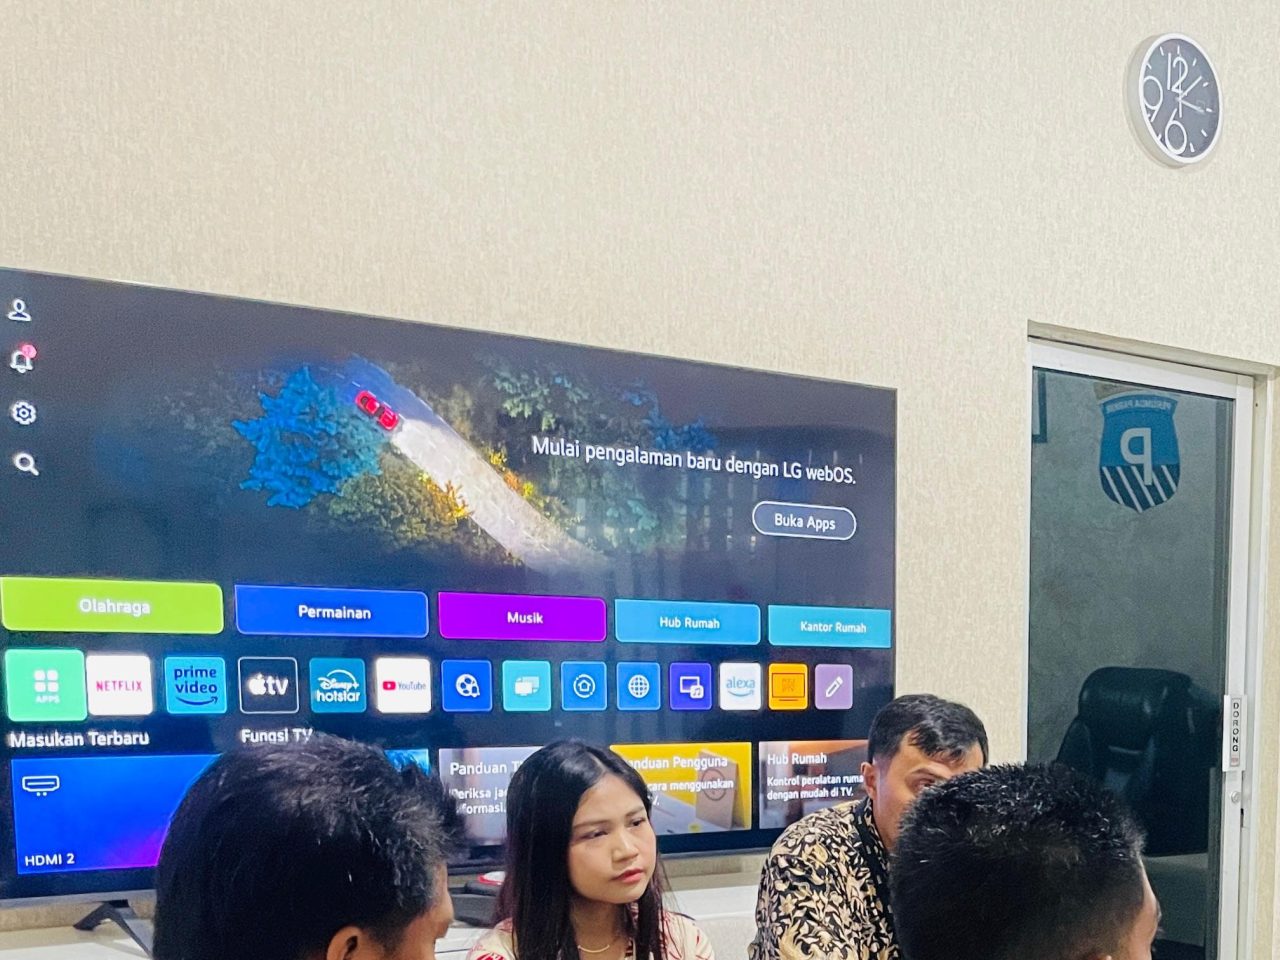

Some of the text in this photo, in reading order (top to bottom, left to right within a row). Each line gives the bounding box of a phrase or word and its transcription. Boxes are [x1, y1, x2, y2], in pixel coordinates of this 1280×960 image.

[1166, 52, 1189, 94] 12
[1164, 108, 1188, 155] 6
[532, 435, 857, 485] Mulai pengalaman baru dengan LG webOS.
[774, 513, 836, 531] Buka Apps
[79, 598, 151, 617] Olahraga
[298, 604, 371, 620] Permainan
[507, 611, 544, 624] Musik
[660, 617, 720, 629] Hub Rumah
[800, 621, 867, 633] Kantor Rumah
[173, 666, 217, 680] prime
[96, 680, 142, 692] NETFLIX
[175, 682, 218, 695] video
[267, 677, 289, 695] tv
[398, 681, 427, 691] YouTube
[726, 676, 756, 688] alexa
[316, 689, 360, 703] hotstar
[1232, 702, 1240, 752] DORONG
[10, 729, 151, 748] Masukan Terbaru
[673, 756, 728, 770] Pengguna
[767, 752, 828, 765] Hub Rumah
[450, 761, 508, 776] Panduan
[670, 778, 734, 792] menggunakan
[766, 774, 865, 787] Kontrol peralatan ruma
[766, 786, 854, 802] dengan mudah di TV.
[24, 853, 75, 866] HDMI 2
